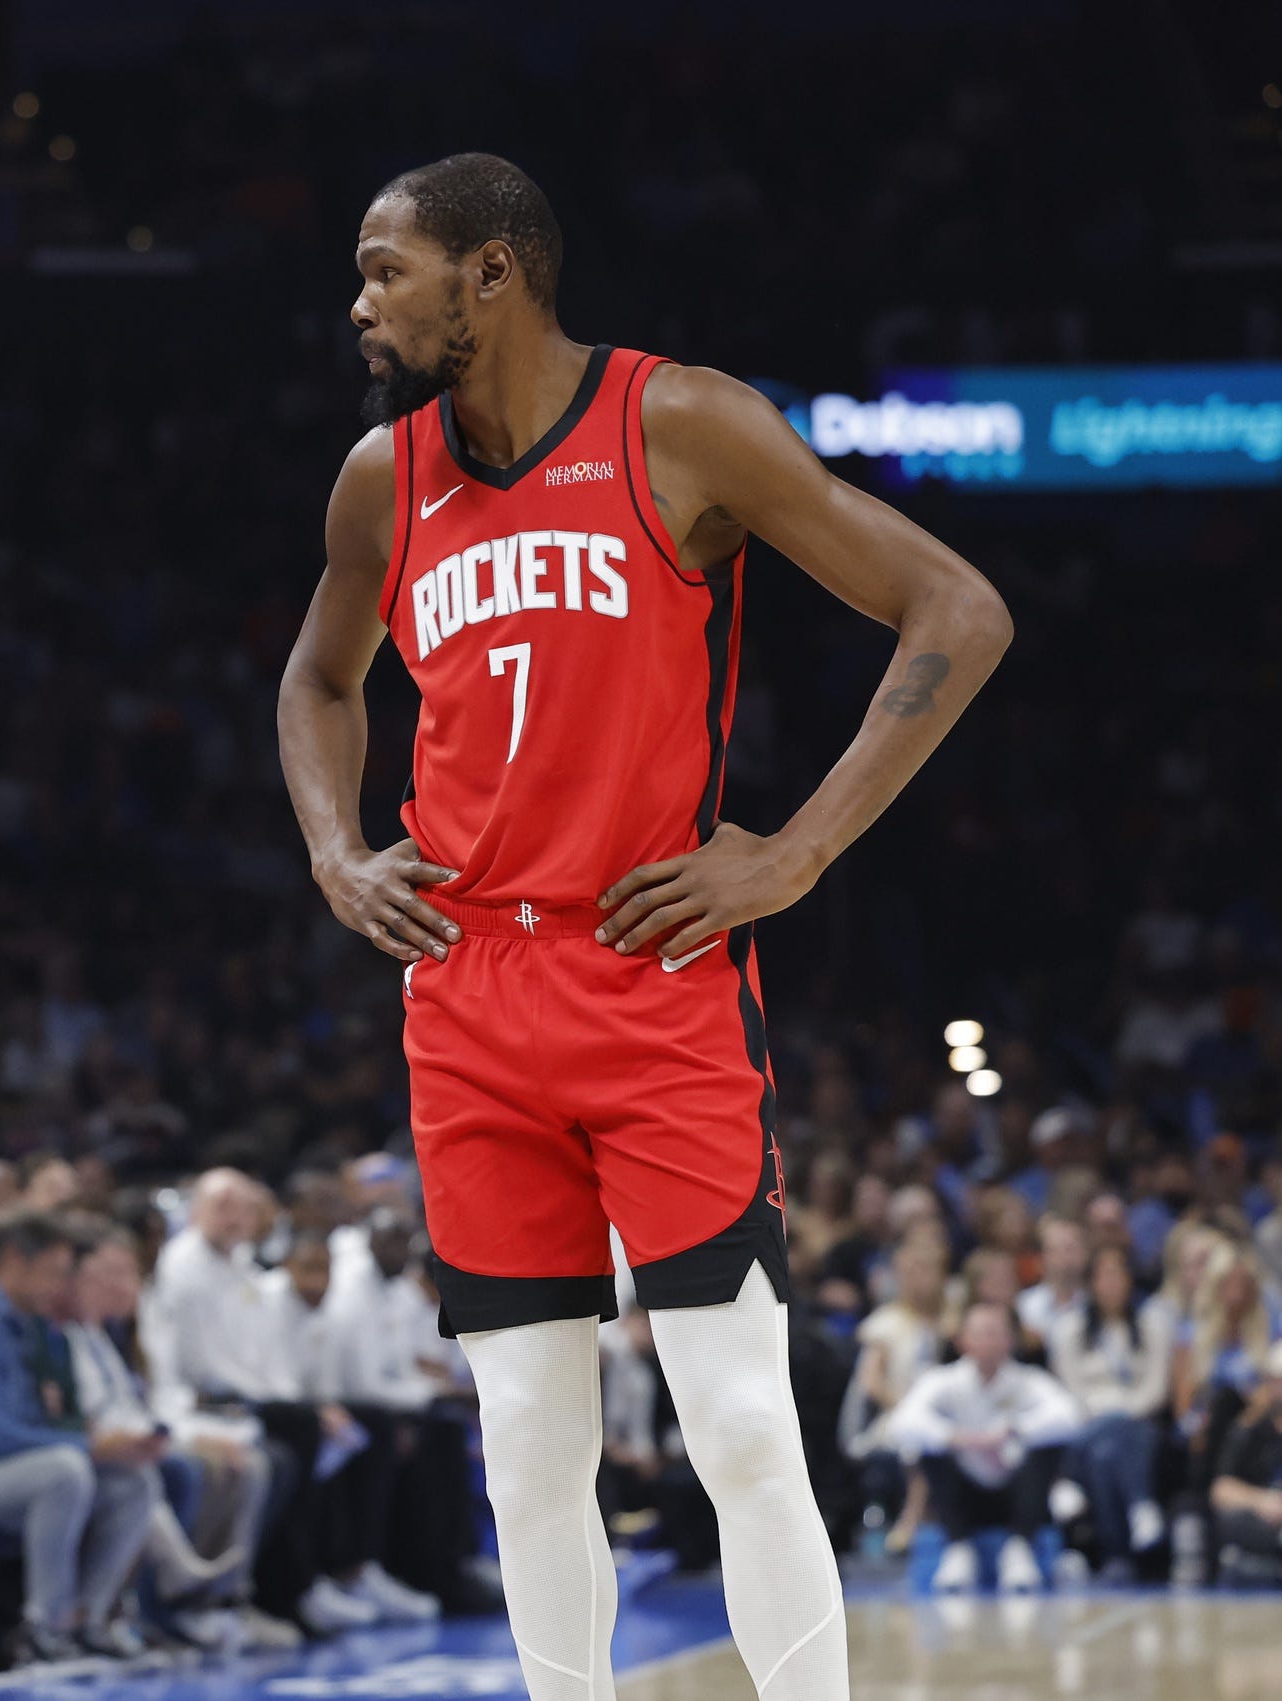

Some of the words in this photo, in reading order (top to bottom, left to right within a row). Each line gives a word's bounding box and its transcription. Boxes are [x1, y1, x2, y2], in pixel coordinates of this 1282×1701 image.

[546, 461, 614, 477] MEMORIAL
[546, 470, 614, 486] HERMANN
[412, 530, 629, 662] ROCKETS
[488, 642, 531, 765] 7
